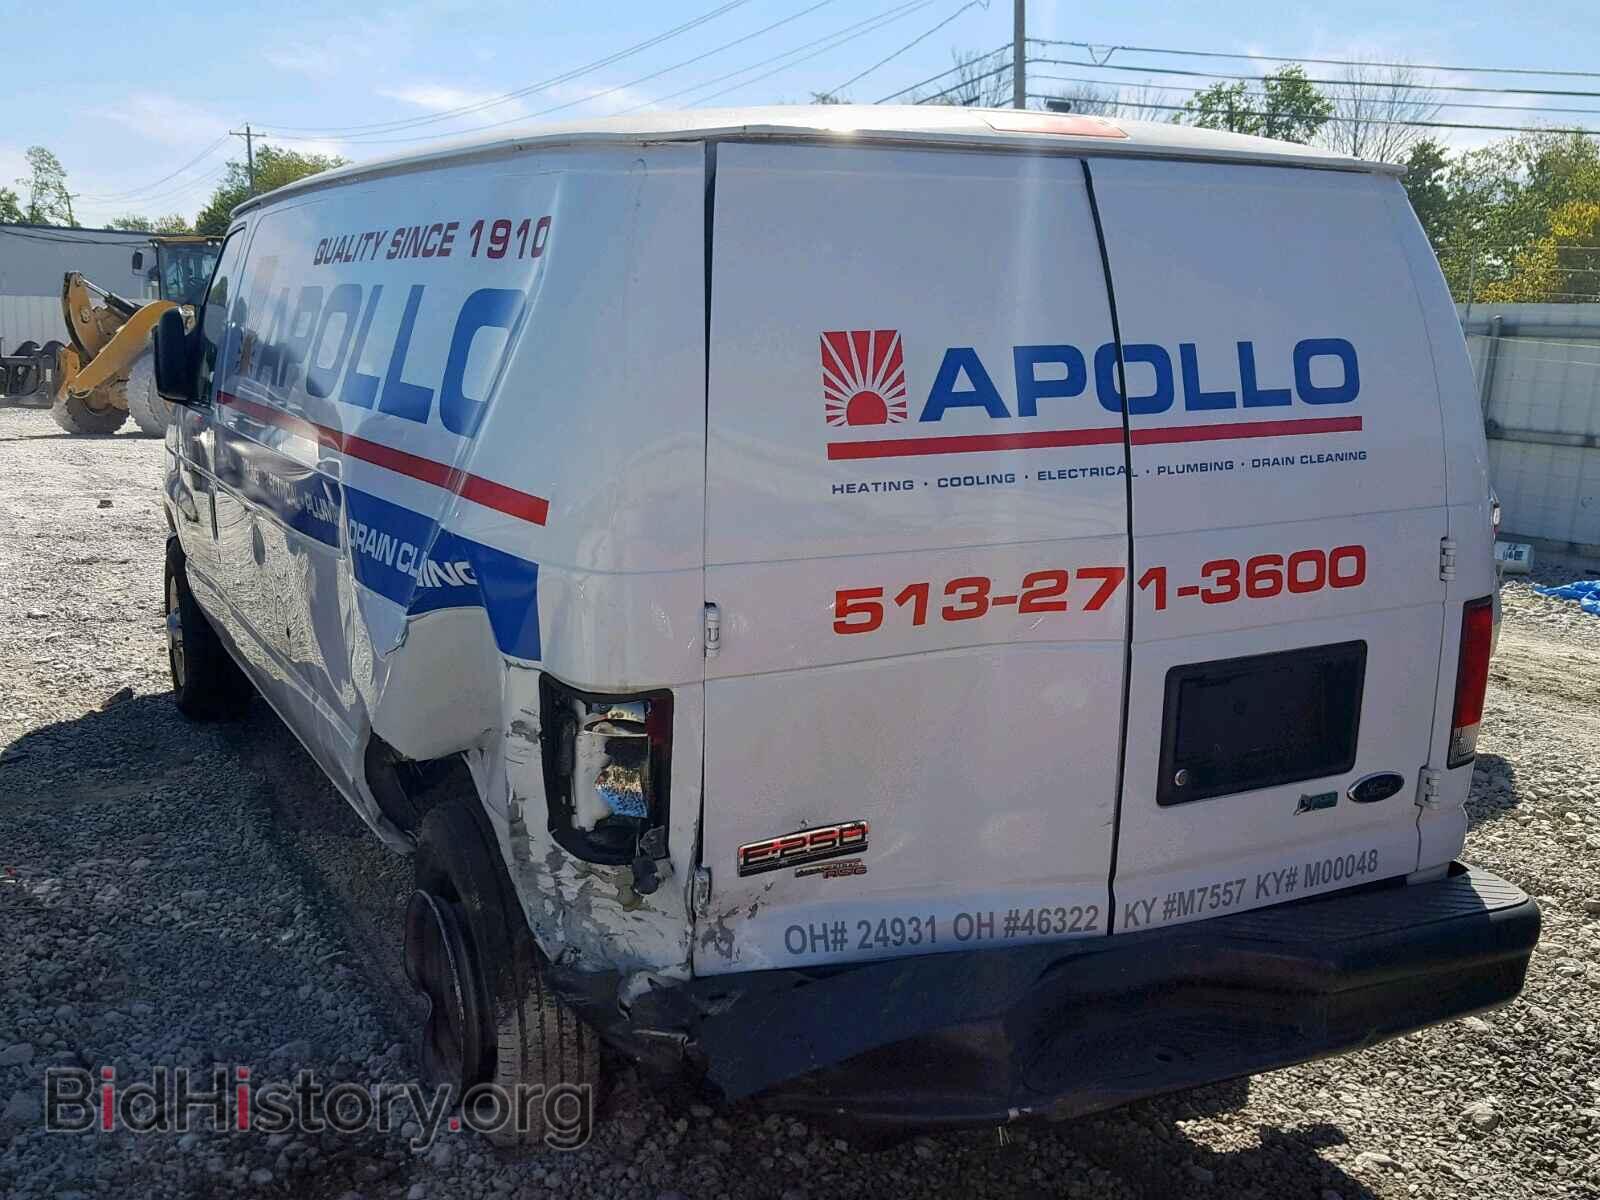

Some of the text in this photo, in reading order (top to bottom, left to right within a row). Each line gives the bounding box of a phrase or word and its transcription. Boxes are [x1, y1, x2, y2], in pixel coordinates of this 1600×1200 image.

[313, 215, 552, 266] QUALITY SINCE 1910
[918, 337, 1360, 423] APOLLO
[831, 450, 1368, 494] HEATING COOLING ELECTRICAL PLUMBING DRAIN CLEANING
[350, 519, 398, 566] DRAIN
[833, 544, 1367, 635] 513-271-3600
[740, 823, 868, 866] E250
[1123, 848, 1379, 929] KY #M7557 KY# M00048
[784, 904, 1099, 955] OH# 24931 OH #46322
